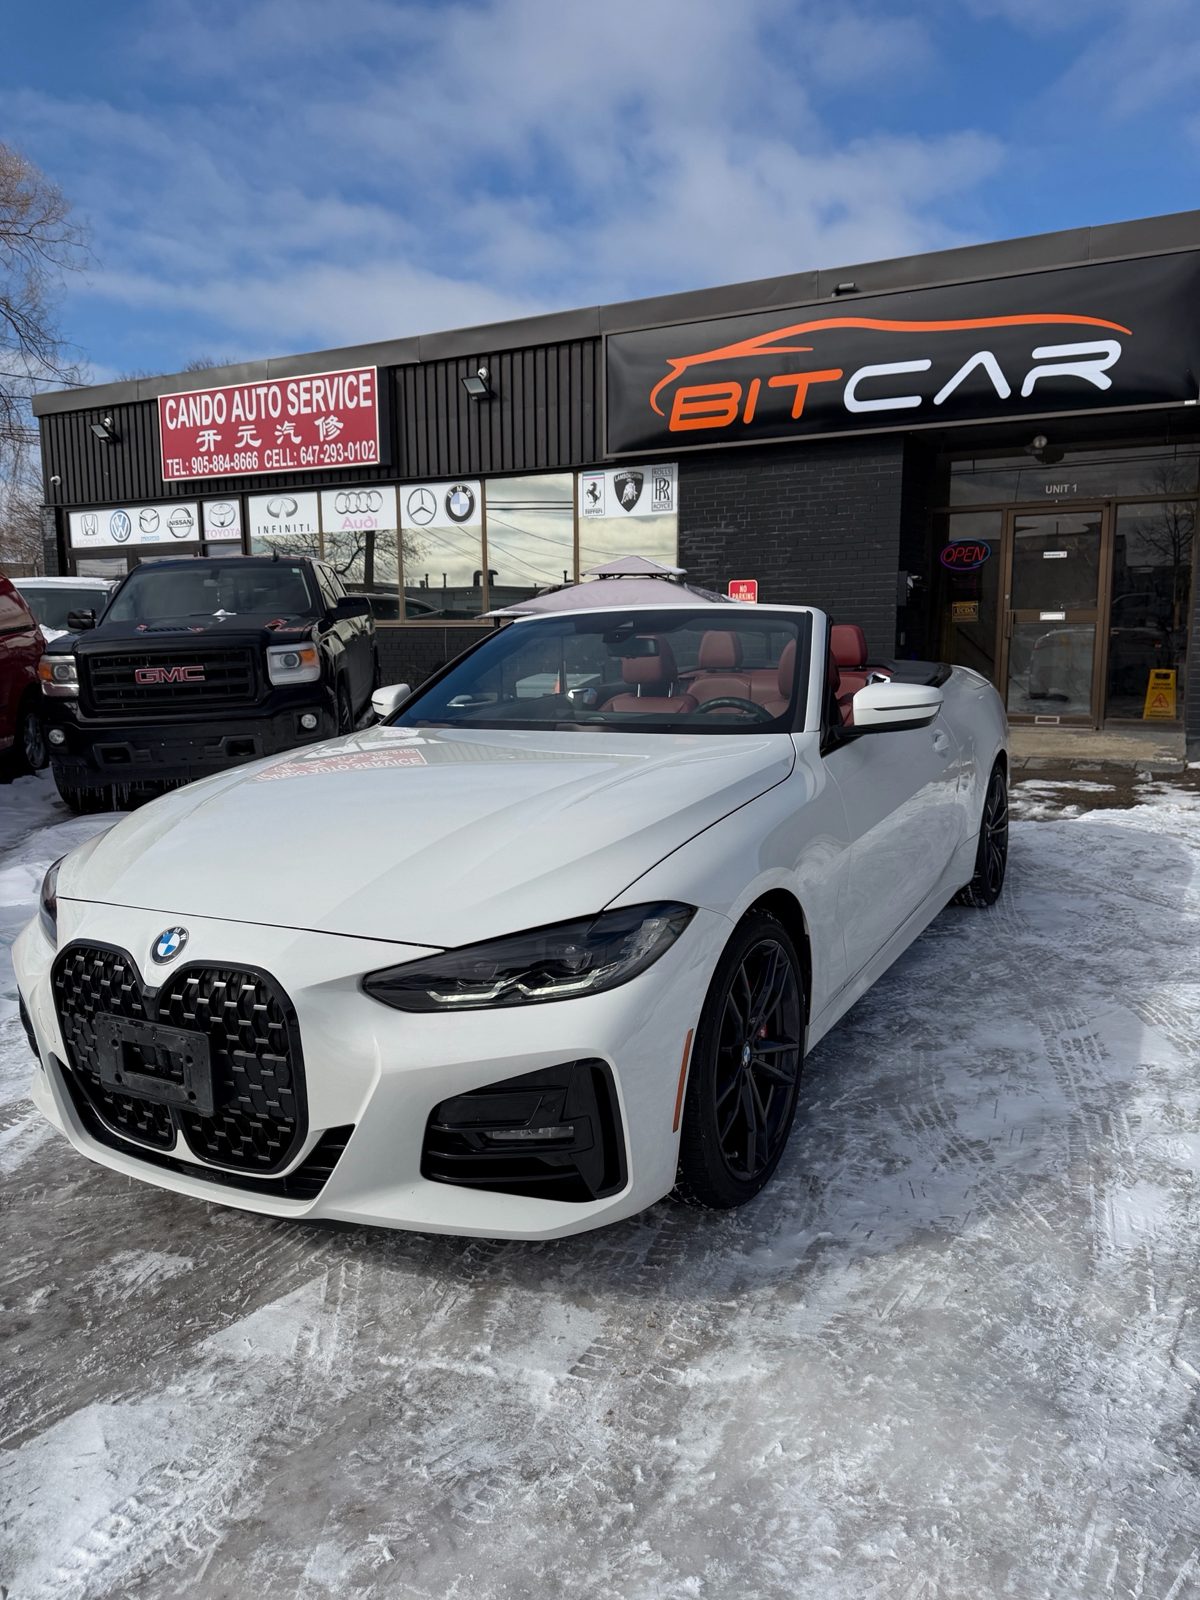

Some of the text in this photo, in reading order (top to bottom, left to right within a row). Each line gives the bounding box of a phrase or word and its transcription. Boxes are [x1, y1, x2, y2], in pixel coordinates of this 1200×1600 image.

[669, 339, 1122, 431] BITCAR
[165, 372, 373, 430] CANDO AUTO SERVICE
[167, 439, 376, 477] TEL: 905-884-8666 CELL: 647-293-0102
[447, 485, 472, 498] BMW
[1045, 483, 1078, 494] UNIT 1
[168, 518, 192, 526] NISSAN
[257, 523, 311, 534] INFINITI
[341, 516, 378, 530] Audi
[205, 528, 242, 538] TOYOTA
[943, 546, 986, 562] OPEN
[739, 584, 748, 593] NO
[732, 592, 755, 601] PARKING
[135, 665, 205, 685] GMC
